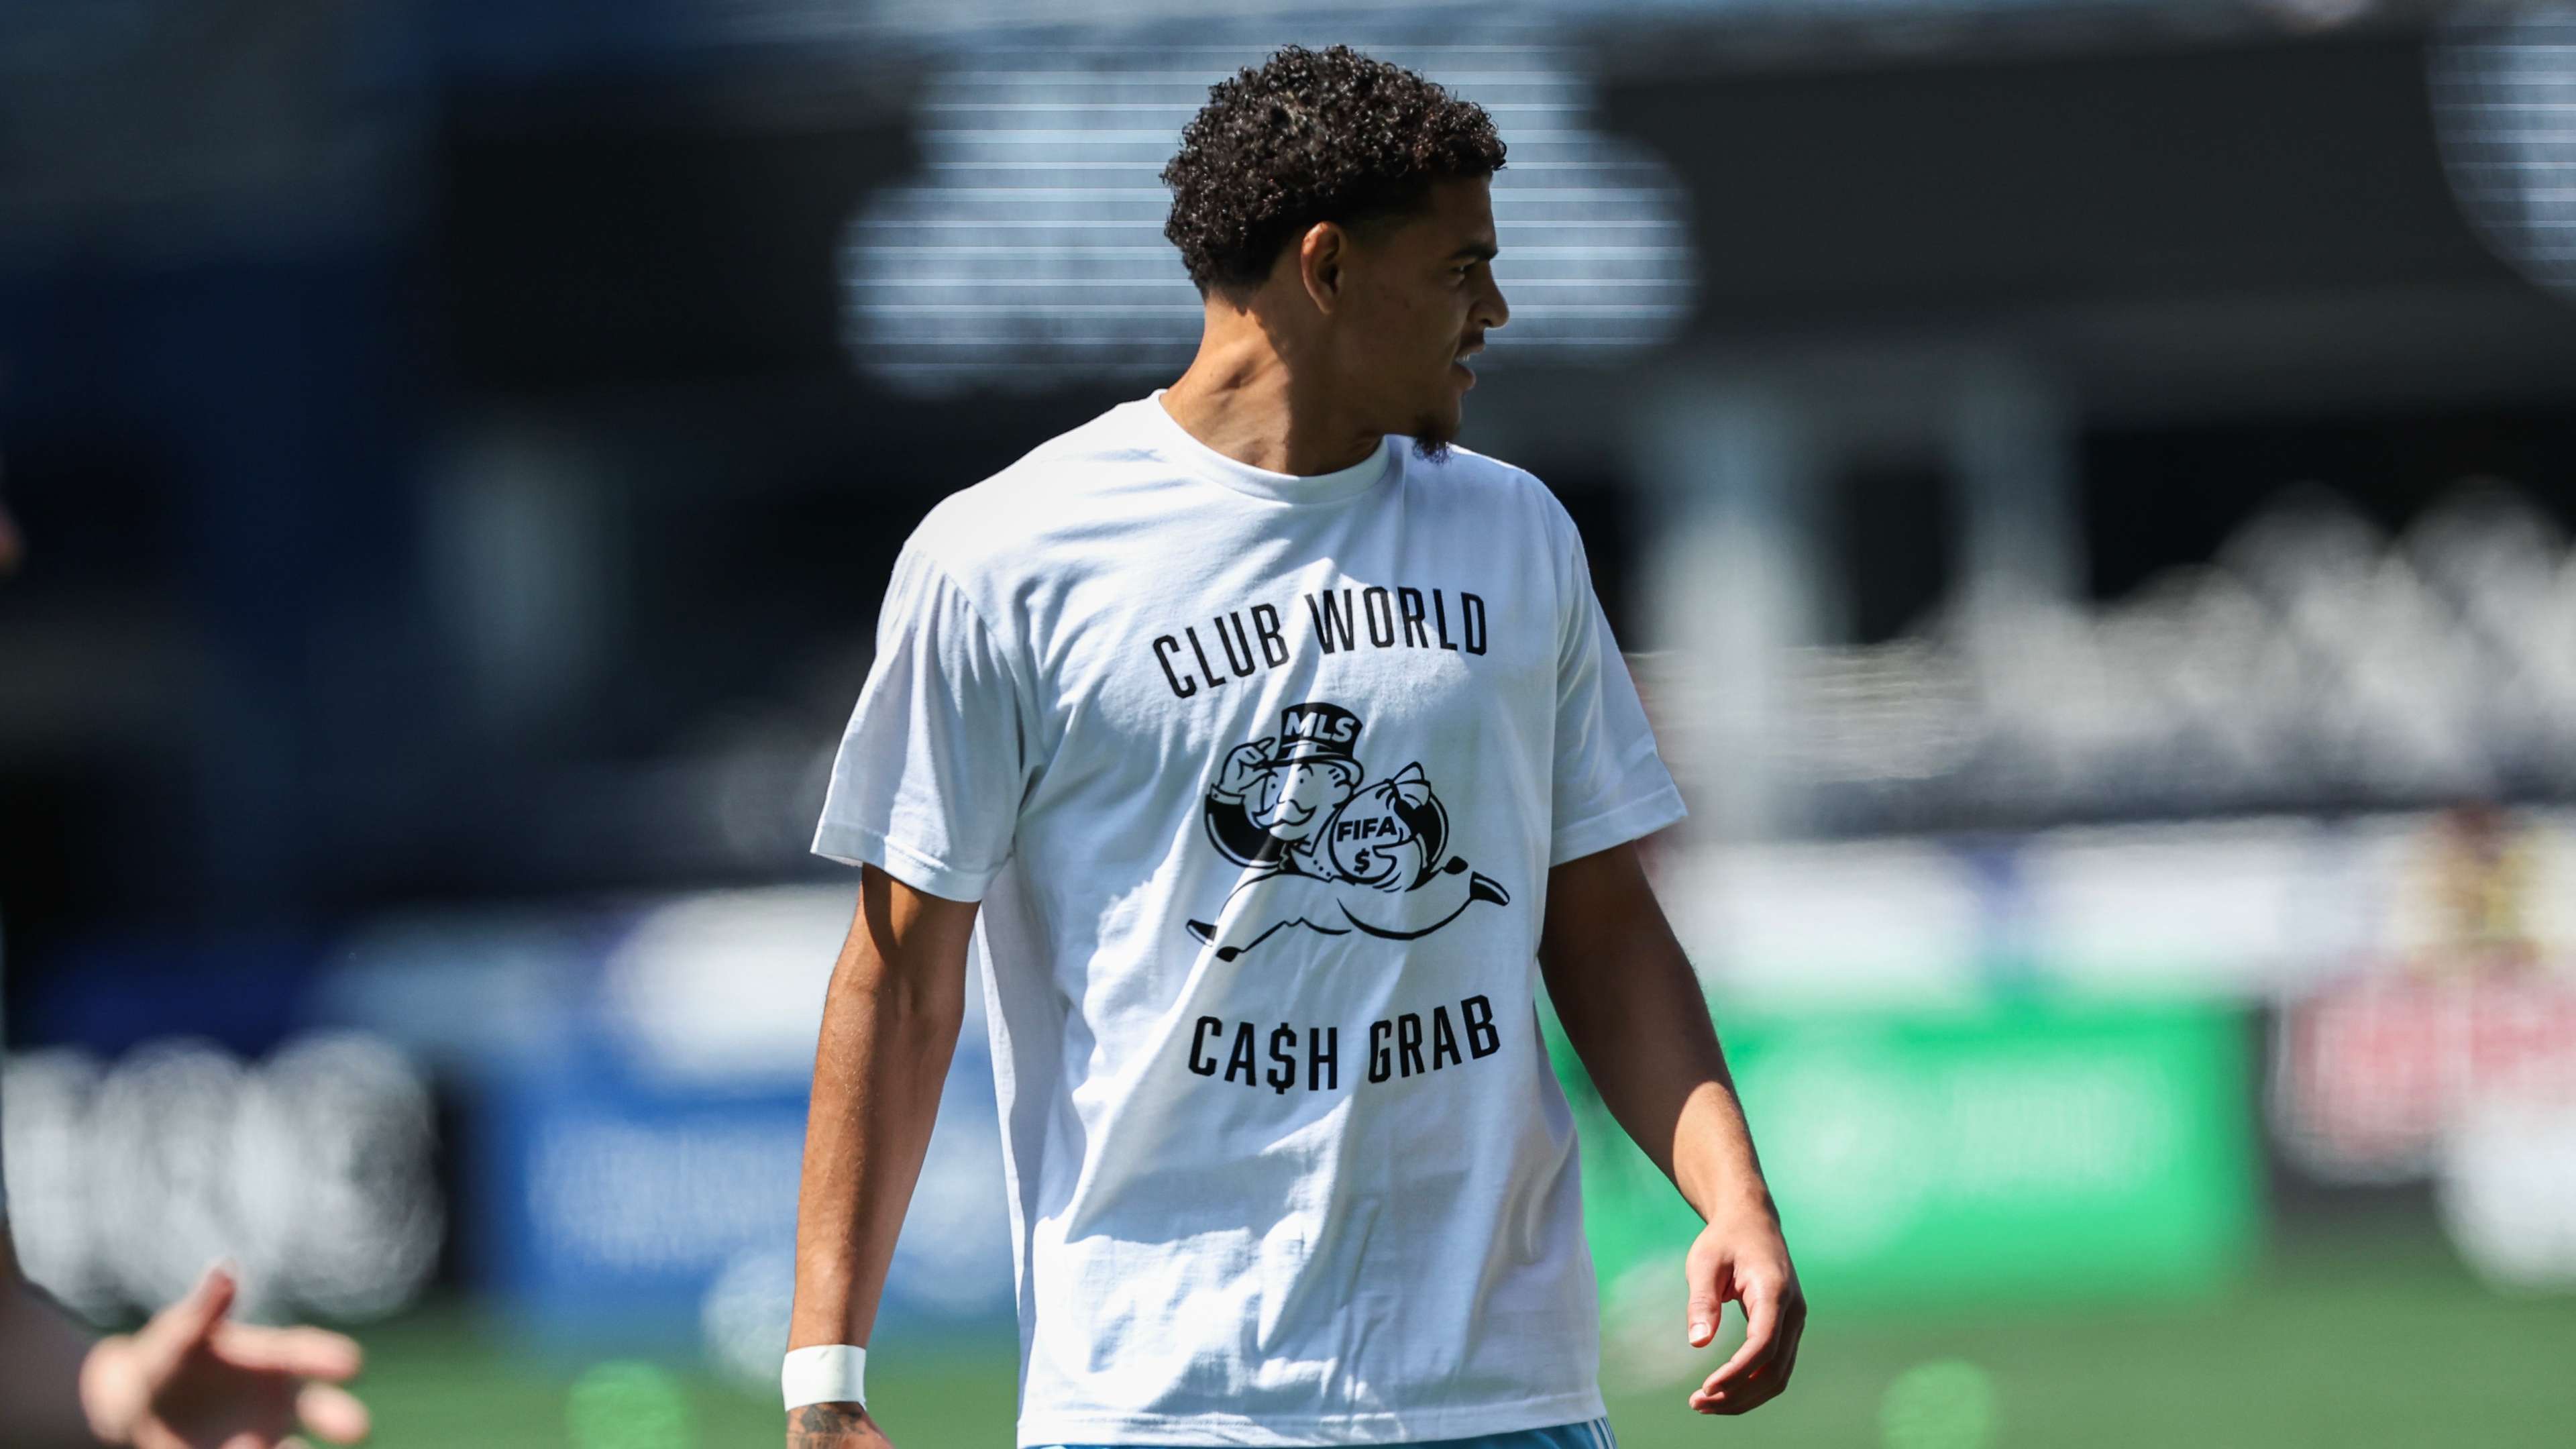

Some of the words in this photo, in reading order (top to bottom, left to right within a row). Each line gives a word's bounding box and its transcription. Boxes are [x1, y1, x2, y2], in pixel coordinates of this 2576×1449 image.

[1152, 603, 1289, 699] CLUB
[1304, 586, 1487, 657] WORLD
[1283, 711, 1356, 743] MLS
[1336, 816, 1398, 843] FIFA
[1353, 847, 1371, 875] $
[1188, 1016, 1338, 1095] CA$H
[1367, 994, 1501, 1085] GRAB
